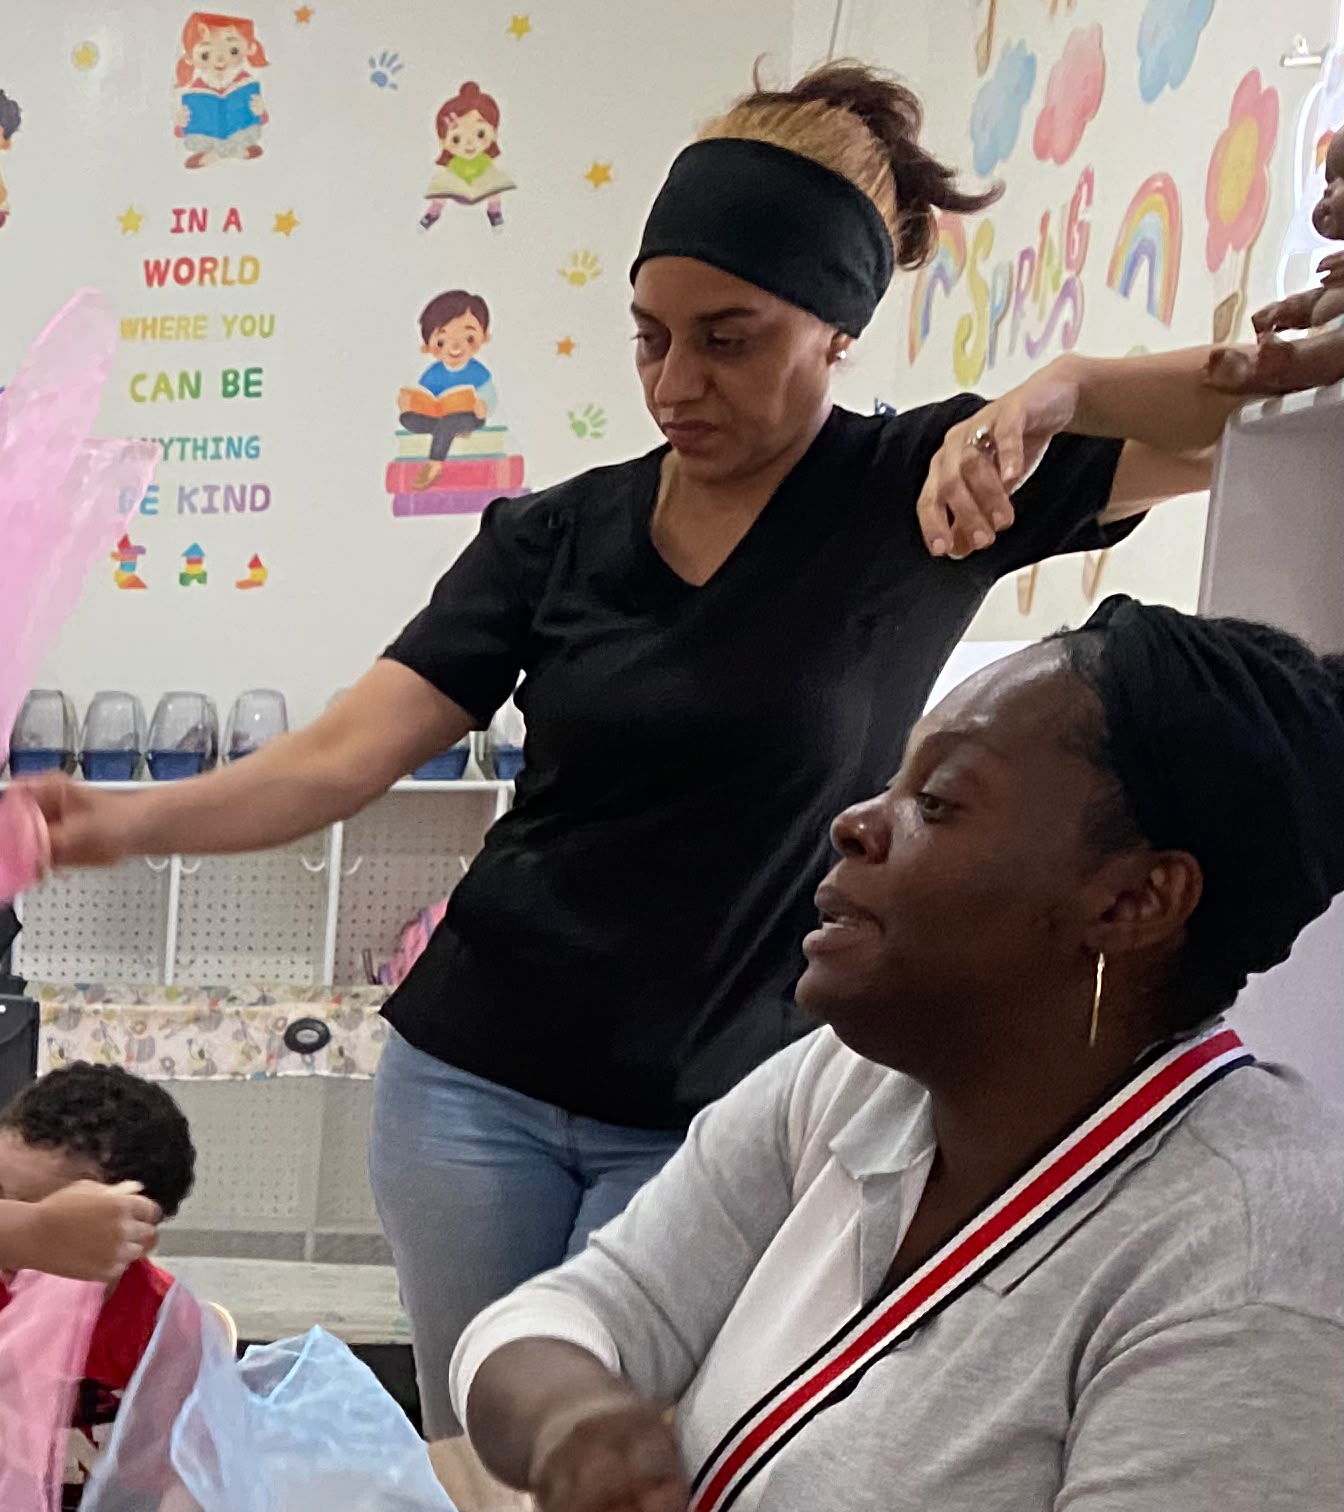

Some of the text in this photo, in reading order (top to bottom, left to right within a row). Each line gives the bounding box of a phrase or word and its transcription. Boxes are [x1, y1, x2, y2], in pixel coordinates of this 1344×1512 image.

[170, 207, 243, 234] IN A
[143, 255, 261, 288] WORLD
[119, 313, 276, 341] WHERE YOU
[129, 366, 264, 403] CAN BE
[177, 483, 272, 516] KIND
